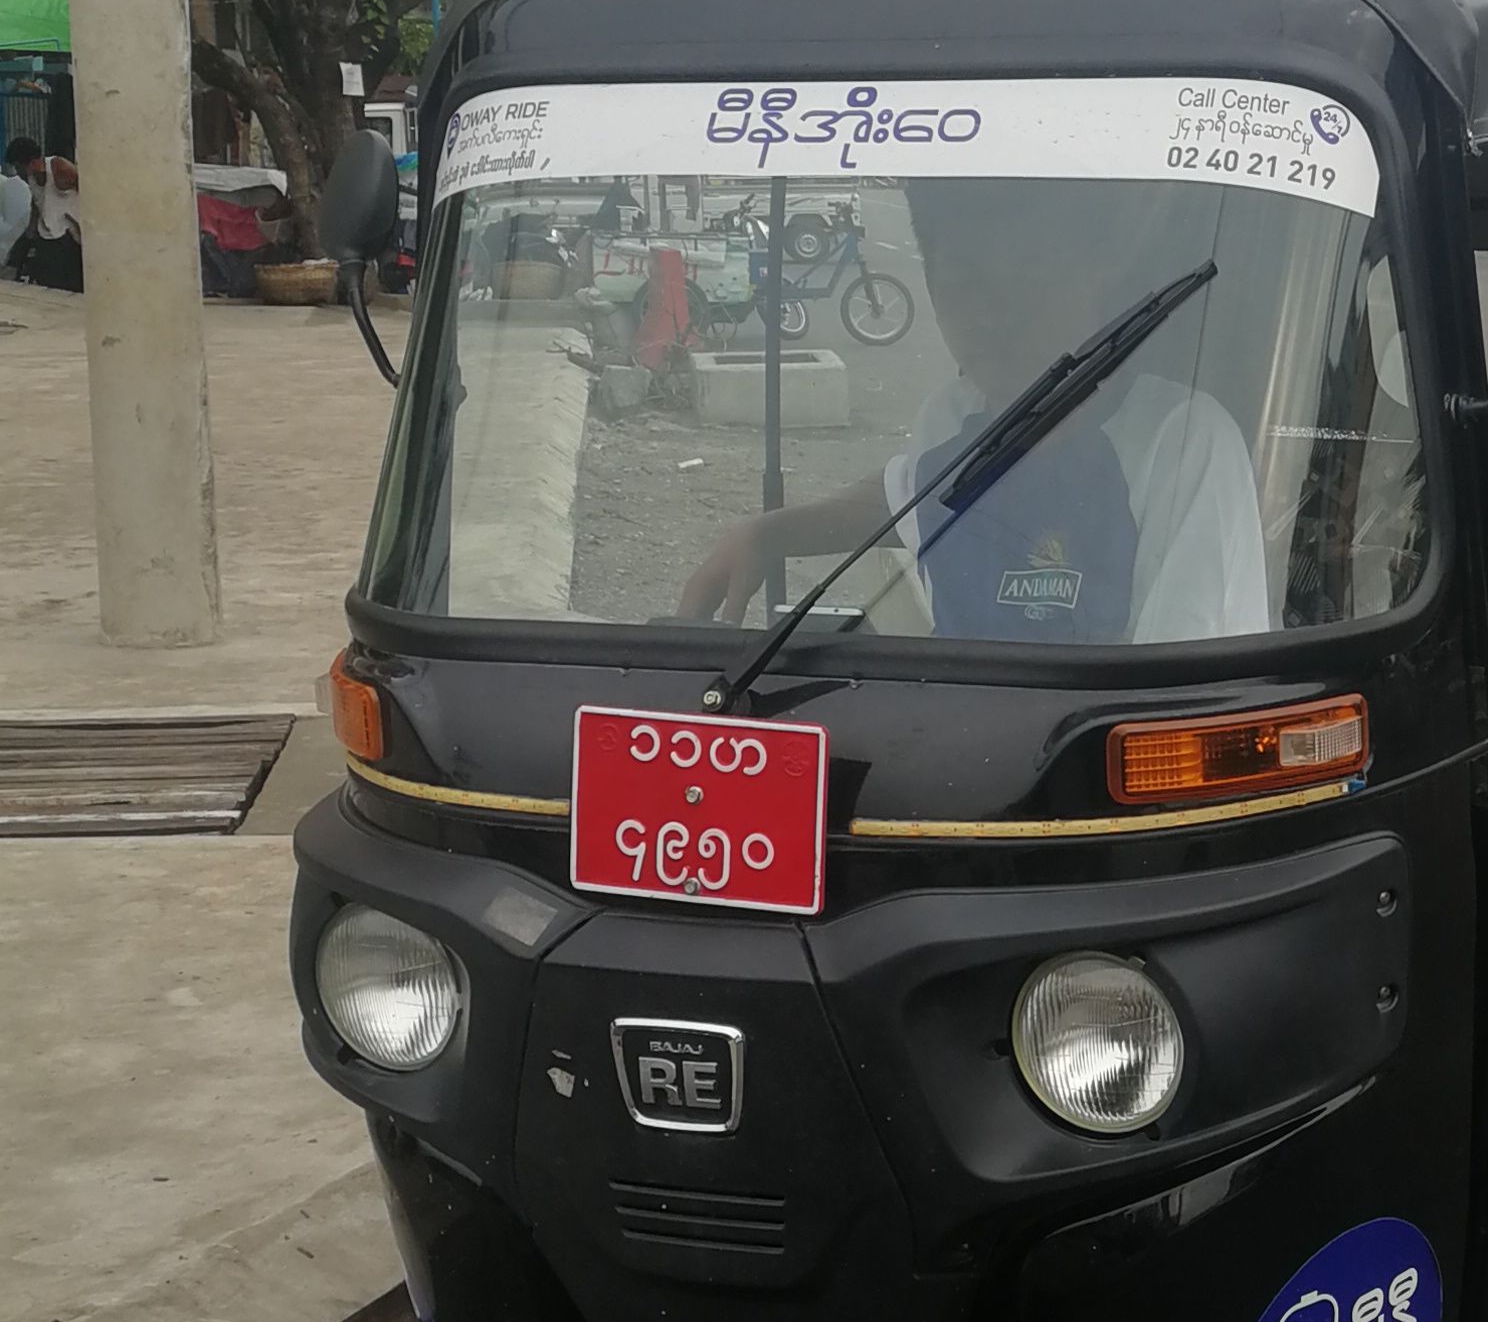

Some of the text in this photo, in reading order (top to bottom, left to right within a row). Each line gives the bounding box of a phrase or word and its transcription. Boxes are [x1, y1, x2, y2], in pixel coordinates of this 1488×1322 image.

[461, 101, 550, 131] OWAY RIDE
[1178, 87, 1290, 115] Call Center
[1167, 146, 1337, 190] 02 40 21 219
[649, 1041, 704, 1055] BAJAJ
[638, 1056, 722, 1109] RE
